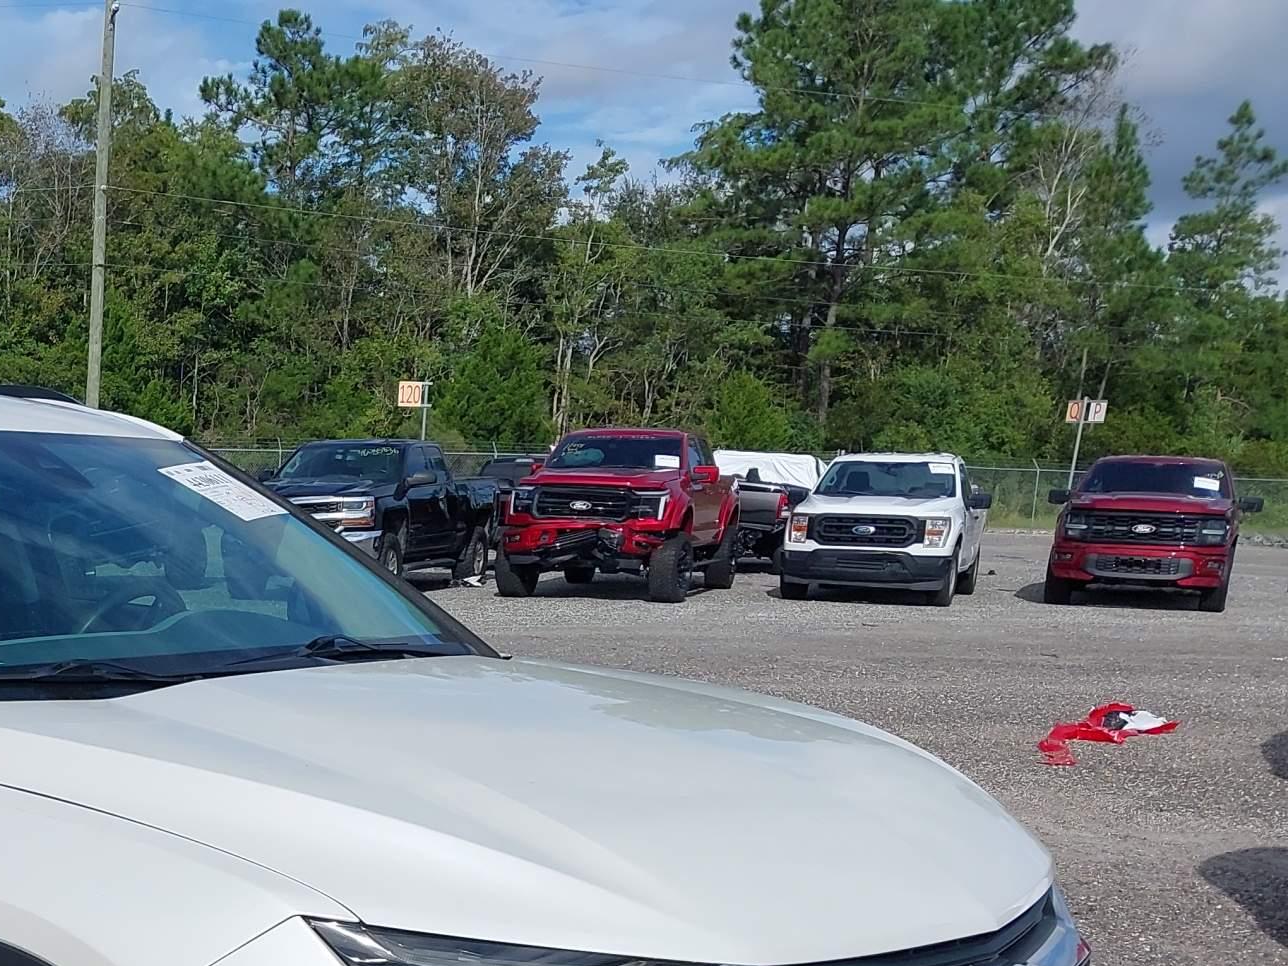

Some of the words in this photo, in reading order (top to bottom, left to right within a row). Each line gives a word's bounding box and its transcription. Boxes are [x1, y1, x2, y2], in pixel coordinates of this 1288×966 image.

[400, 385, 420, 403] 120
[1070, 402, 1080, 421] Q
[1093, 403, 1102, 420] P
